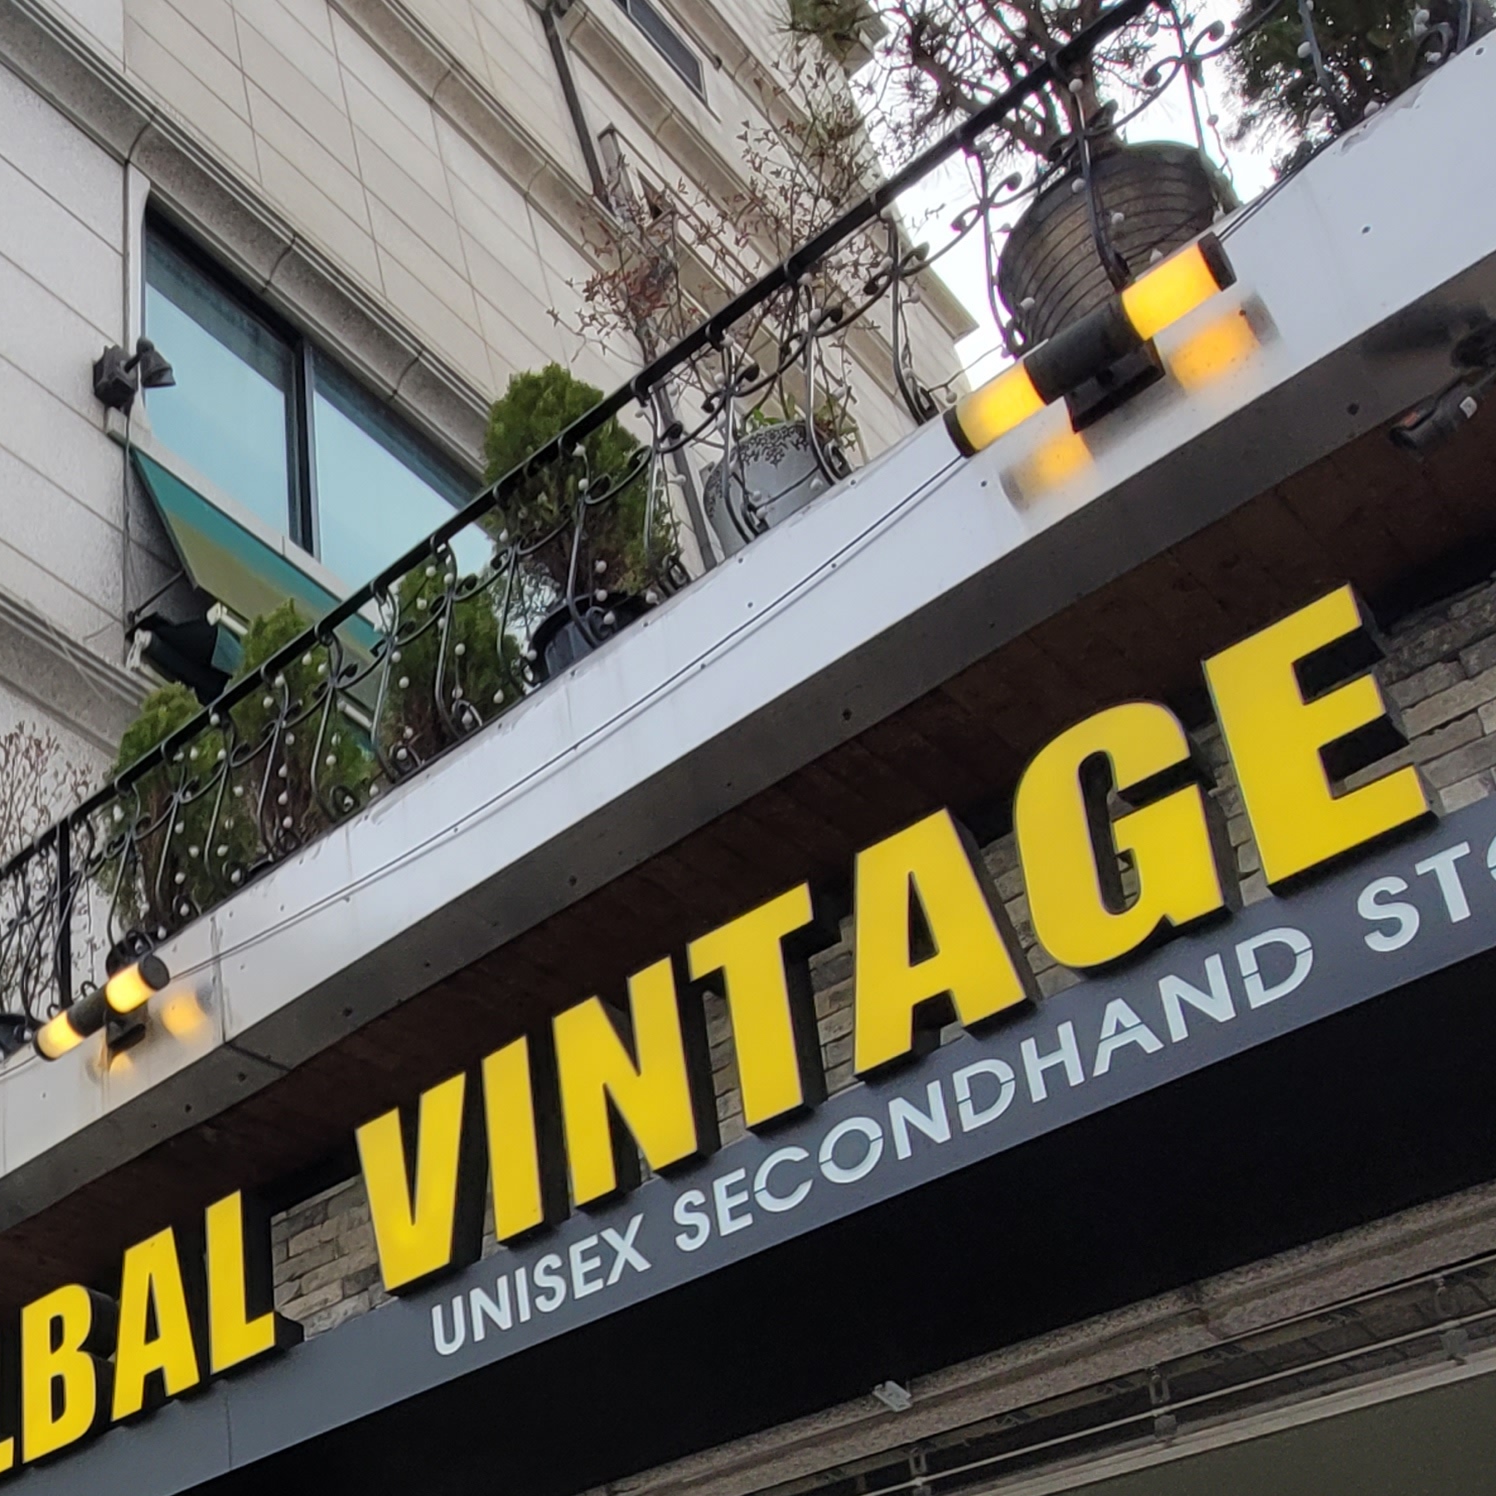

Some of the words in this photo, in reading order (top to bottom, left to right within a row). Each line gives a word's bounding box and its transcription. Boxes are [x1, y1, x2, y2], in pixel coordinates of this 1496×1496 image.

[354, 584, 1430, 1293] VINTAGE
[430, 1213, 653, 1358] UNISEX
[674, 926, 1315, 1252] SECONDHAND
[1357, 834, 1496, 952] ST
